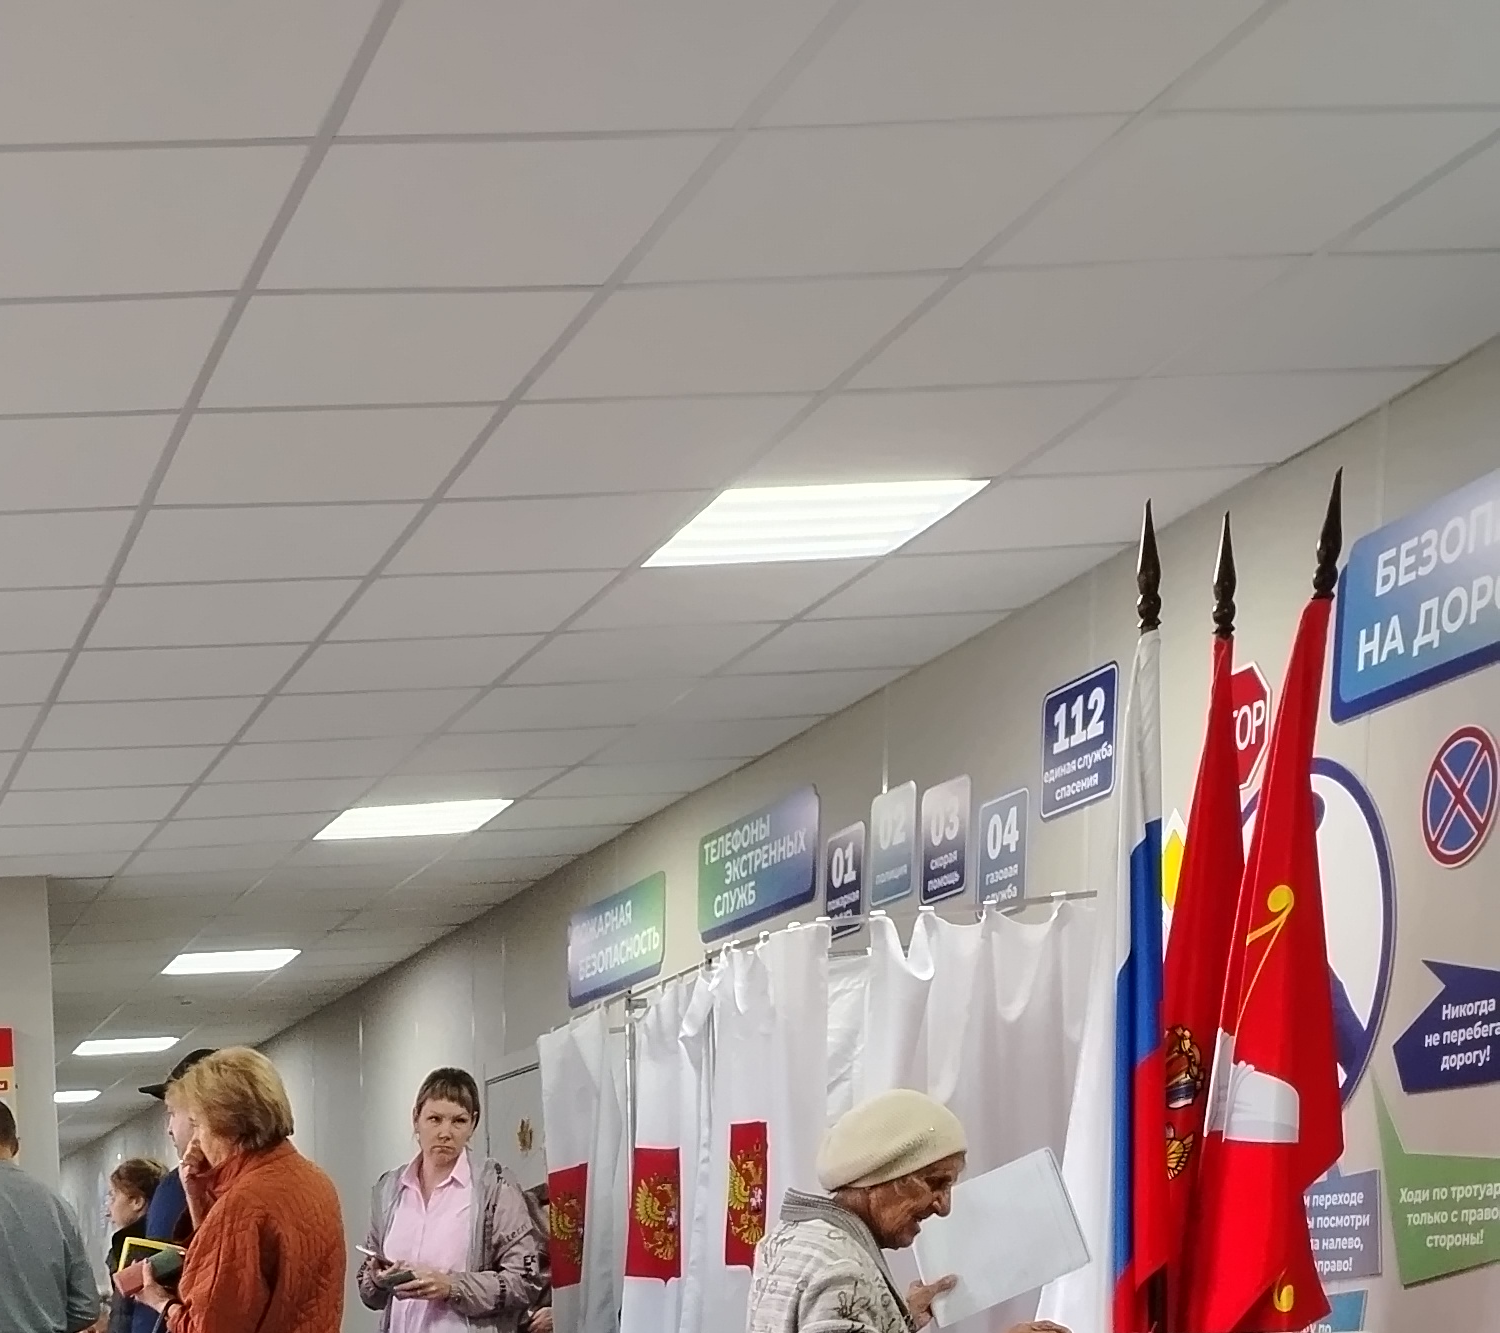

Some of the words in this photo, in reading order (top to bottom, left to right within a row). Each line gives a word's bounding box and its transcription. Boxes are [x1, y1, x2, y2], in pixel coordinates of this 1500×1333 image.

[1375, 500, 1500, 598] БЕЗОП
[1357, 614, 1405, 672] НА
[1412, 574, 1500, 658] ДОР
[1053, 687, 1105, 755] 112
[1233, 699, 1266, 751] OP
[1043, 758, 1077, 784] единая
[1077, 741, 1113, 771] служба
[1055, 773, 1099, 801] спасения
[703, 814, 771, 866] ТЕЛЕФОНЫ
[879, 802, 907, 850] 02
[930, 795, 960, 847] 03
[987, 806, 1020, 860] 04
[724, 828, 807, 885] ЭКСТРЕННЫХ
[831, 841, 857, 889] 01
[985, 864, 1019, 886] газовая
[713, 880, 757, 918] СЛУЖБ
[579, 925, 660, 982] БЕЗОПАСНОСТЬ
[1441, 998, 1496, 1021] Никогда
[1424, 1032, 1440, 1048] не
[1440, 1045, 1491, 1071] дорогу!
[1312, 1191, 1364, 1210] переходе
[1399, 1187, 1430, 1205] Ходи
[1432, 1186, 1448, 1200] по
[1316, 1213, 1370, 1231] посмотри
[1406, 1211, 1449, 1226] только
[1450, 1210, 1459, 1223] с
[1461, 1206, 1500, 1225] право
[1322, 1236, 1364, 1252] налево,
[1426, 1228, 1484, 1250] стороны!
[1314, 1256, 1353, 1275] право!
